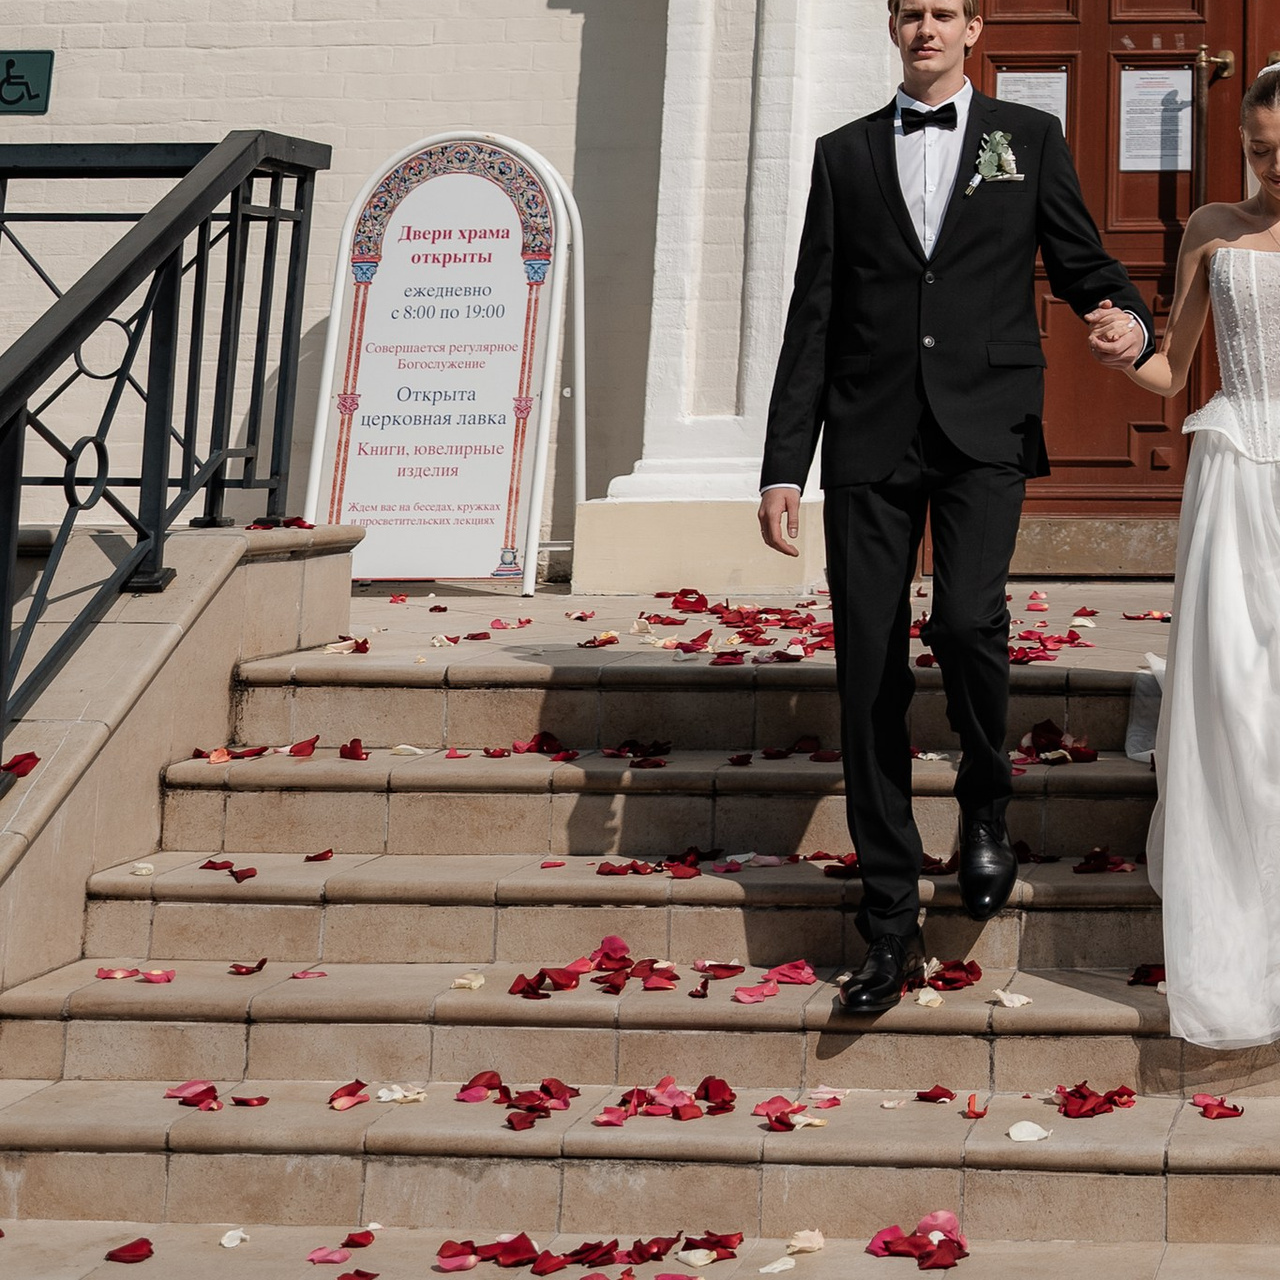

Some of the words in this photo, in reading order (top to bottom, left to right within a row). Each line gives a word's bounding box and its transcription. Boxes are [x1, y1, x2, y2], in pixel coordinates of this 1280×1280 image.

[398, 226, 453, 245] Двери
[458, 228, 510, 244] храма
[411, 252, 492, 268] открыты
[404, 285, 492, 299] ежедневно
[391, 308, 400, 320] с
[403, 305, 436, 320] 8:00
[440, 308, 460, 319] по
[465, 304, 506, 319] 19:00
[365, 342, 446, 356] Совершается
[449, 342, 519, 355] регулярное
[397, 358, 486, 372] Богослужение
[396, 386, 477, 406] Открыта
[360, 414, 452, 430] церковная
[456, 413, 507, 426] лавка
[357, 442, 410, 458] Книги,
[414, 444, 505, 459] ювелирные
[397, 466, 459, 479] изделия
[348, 502, 378, 513] Ждем
[381, 504, 397, 512] вас
[399, 504, 411, 512] на
[413, 502, 455, 513] беседах,
[457, 503, 501, 514] кружках
[350, 518, 357, 526] и
[359, 518, 451, 528] просветительских
[453, 517, 495, 527] лекциях
